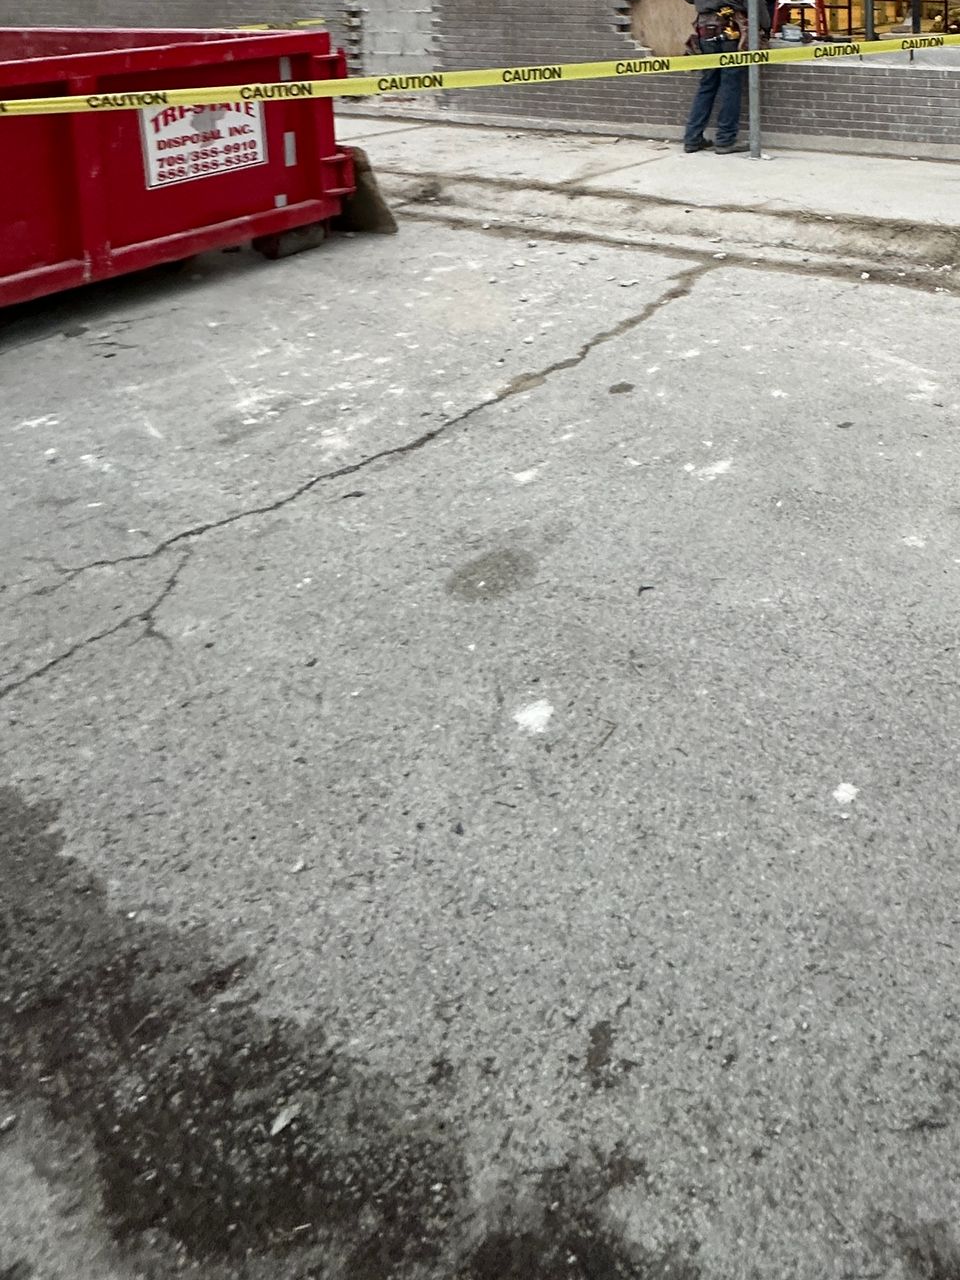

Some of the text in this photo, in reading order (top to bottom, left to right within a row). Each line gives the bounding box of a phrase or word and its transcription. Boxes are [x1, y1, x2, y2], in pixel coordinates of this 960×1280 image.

[86, 92, 168, 108] CAUTION
[239, 83, 313, 100] CAUTION
[378, 75, 443, 91] CAUTION
[502, 67, 562, 82] CAUTION
[615, 59, 670, 74] CAUTION
[719, 51, 769, 66] CAUTION
[814, 44, 860, 58] CAUTION
[901, 37, 944, 50] CAUTION
[156, 123, 255, 151] DISPOSAL INC.
